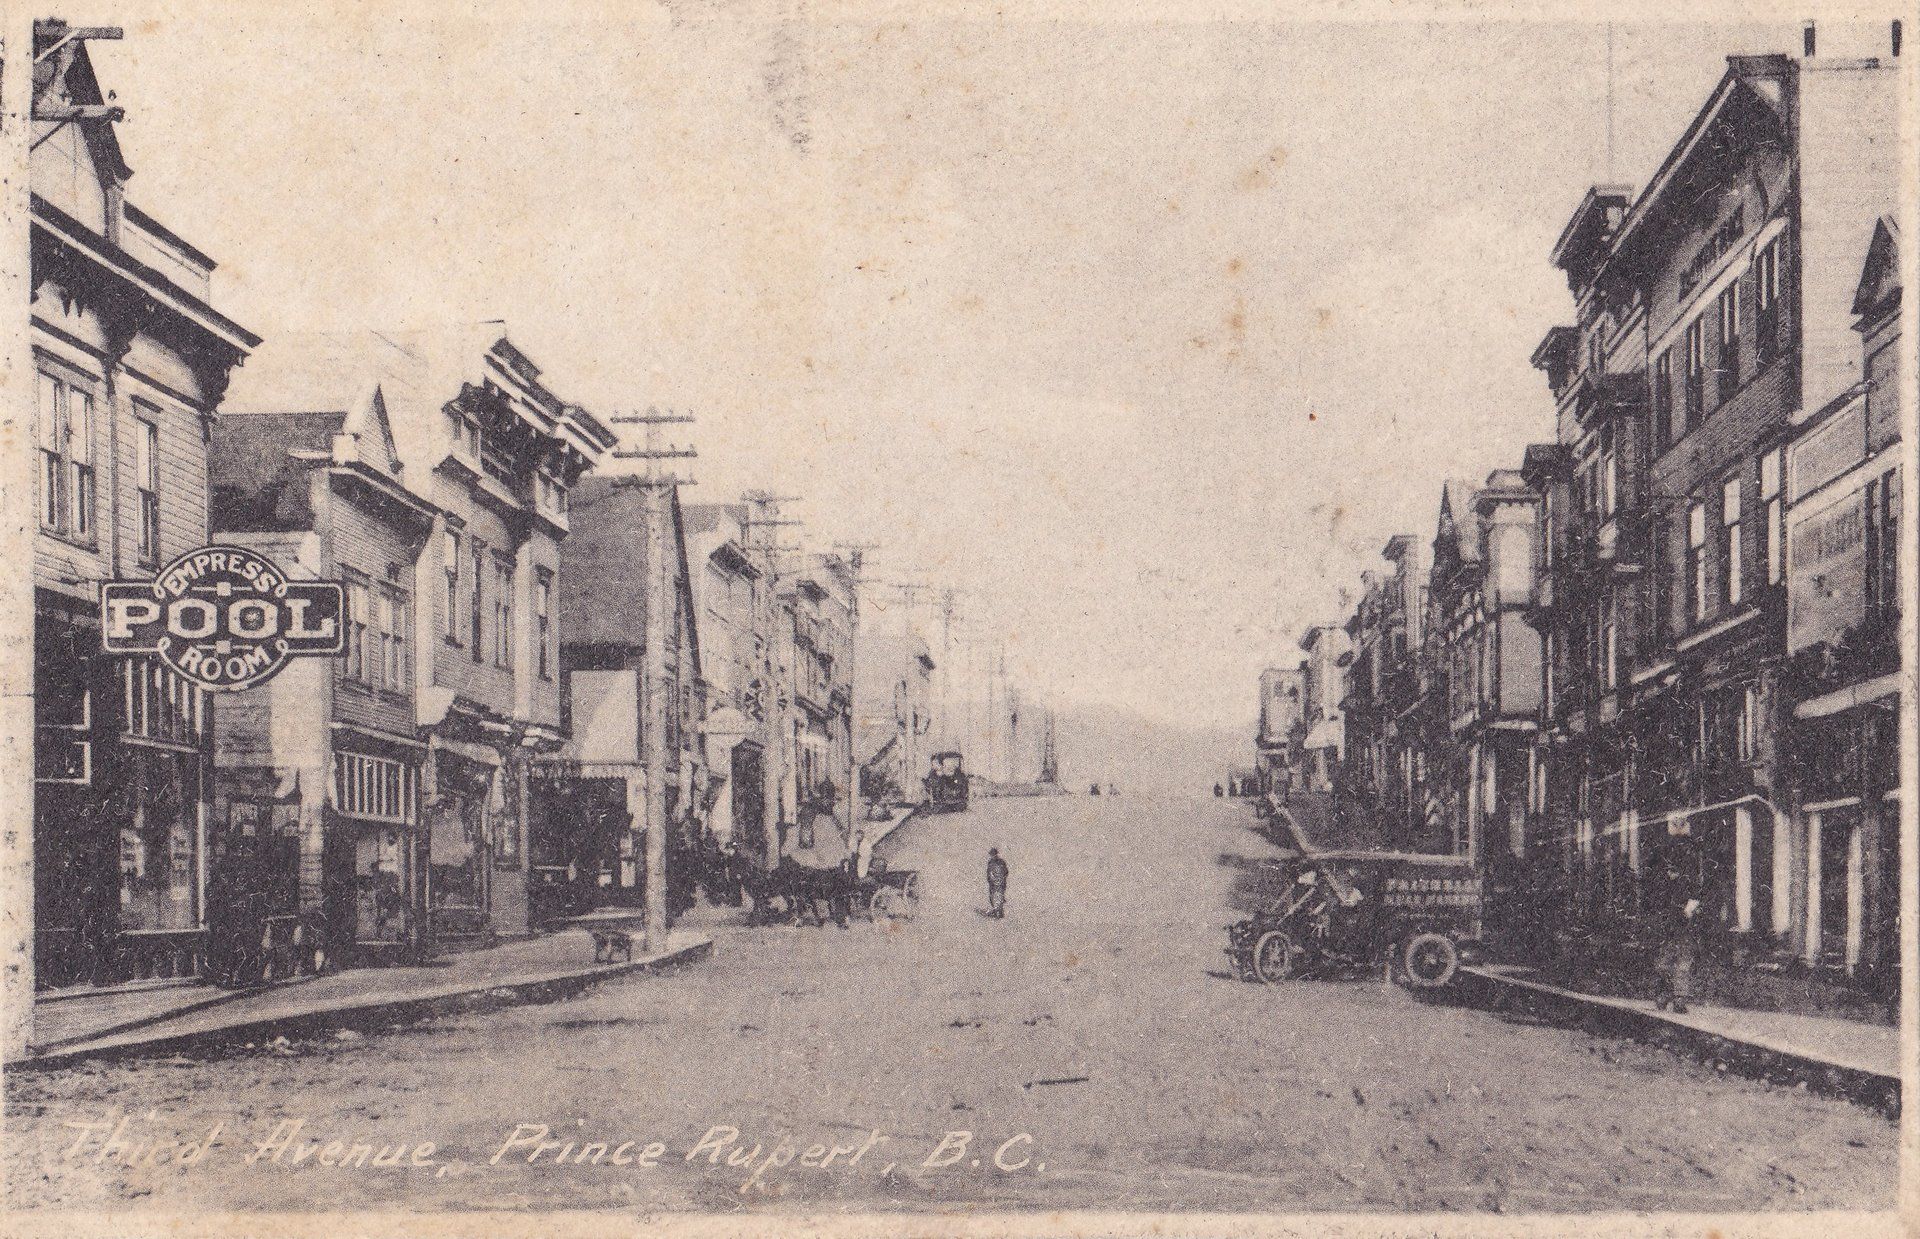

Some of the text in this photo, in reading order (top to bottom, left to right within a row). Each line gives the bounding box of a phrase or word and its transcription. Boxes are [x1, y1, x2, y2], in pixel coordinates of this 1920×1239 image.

[163, 552, 278, 597] EMPRESS
[108, 598, 336, 639] POOL
[177, 645, 274, 681] ROOM
